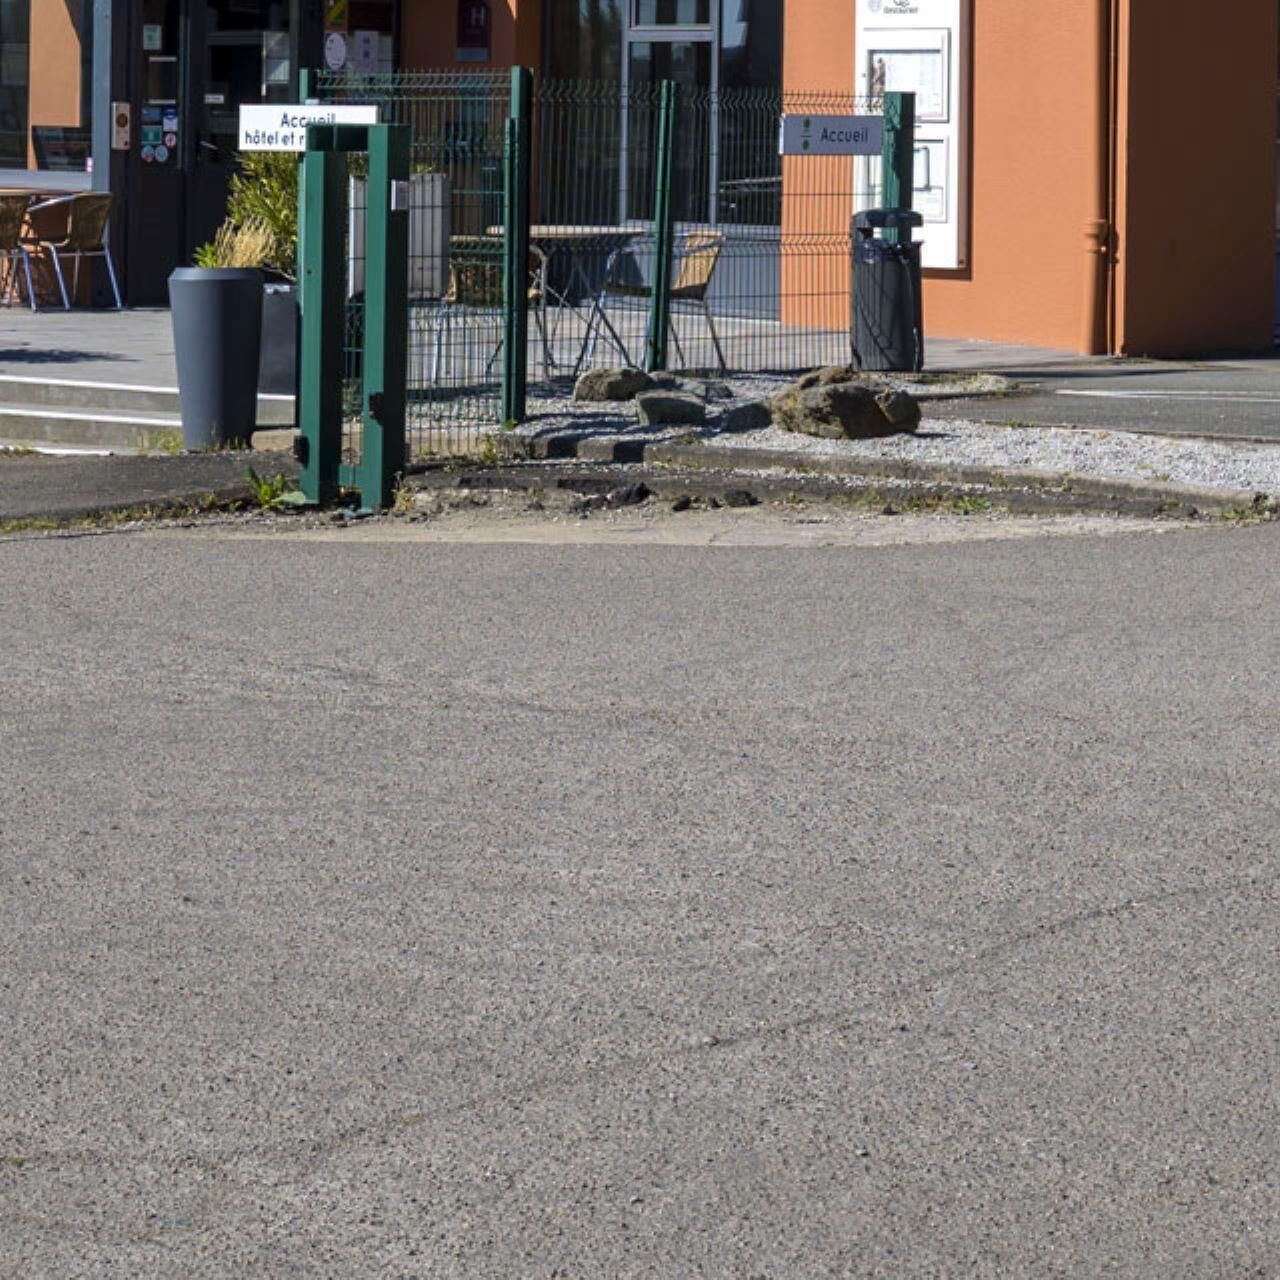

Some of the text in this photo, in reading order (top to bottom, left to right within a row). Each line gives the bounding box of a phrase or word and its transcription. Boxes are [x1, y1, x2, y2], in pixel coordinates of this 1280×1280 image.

[245, 129, 279, 145] hôtel
[281, 131, 296, 146] et
[820, 127, 869, 143] Accueil
